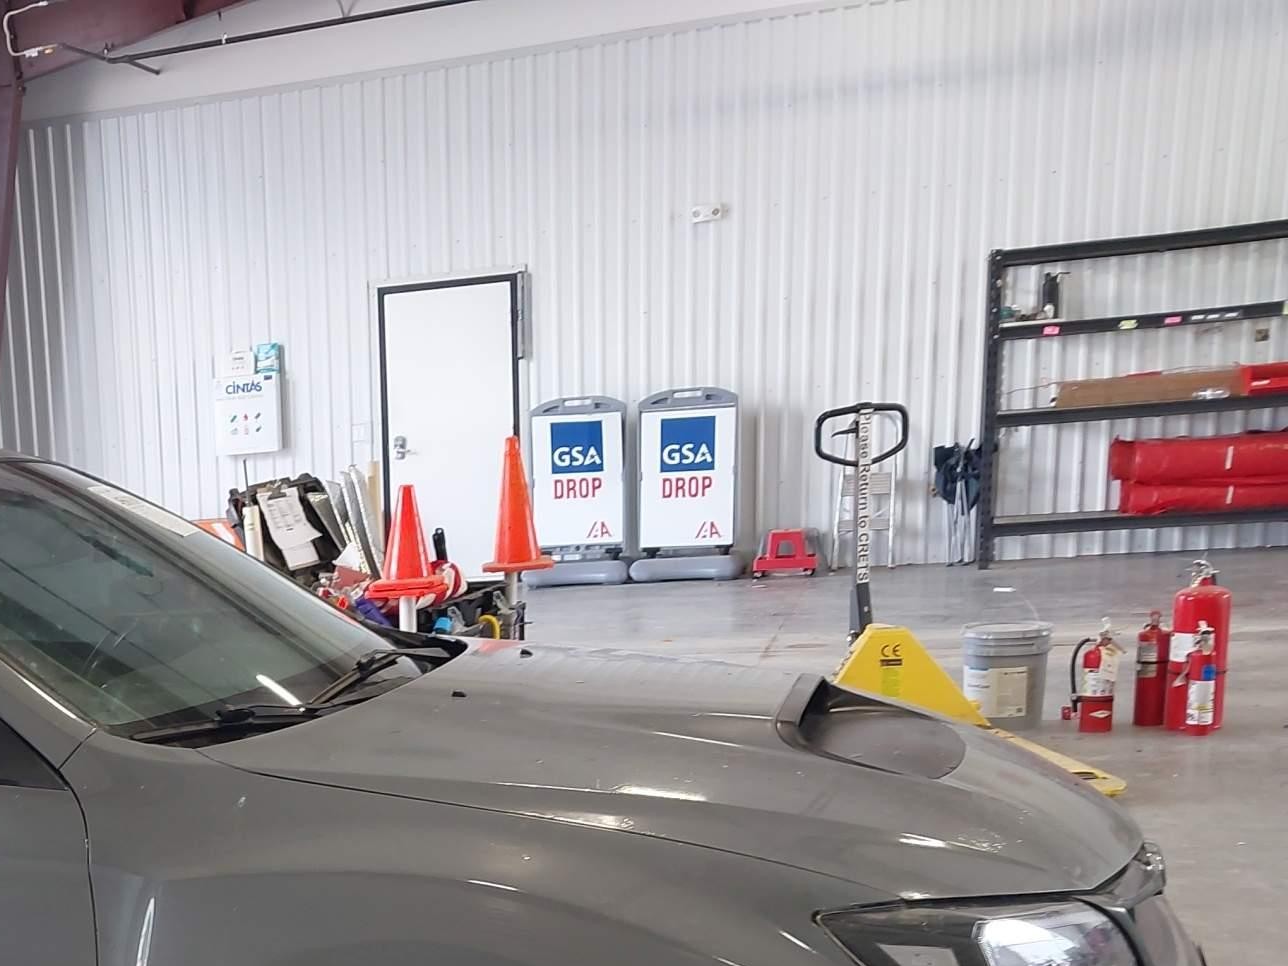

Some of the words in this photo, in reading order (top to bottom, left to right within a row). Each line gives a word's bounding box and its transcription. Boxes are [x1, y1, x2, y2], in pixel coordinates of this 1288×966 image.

[860, 412, 873, 459] Please
[553, 446, 602, 466] GSA
[662, 443, 713, 465] GSA
[554, 477, 602, 499] DROP
[662, 476, 712, 498] DROP
[859, 464, 871, 511] Return
[859, 516, 870, 529] to
[880, 643, 902, 657] CE
